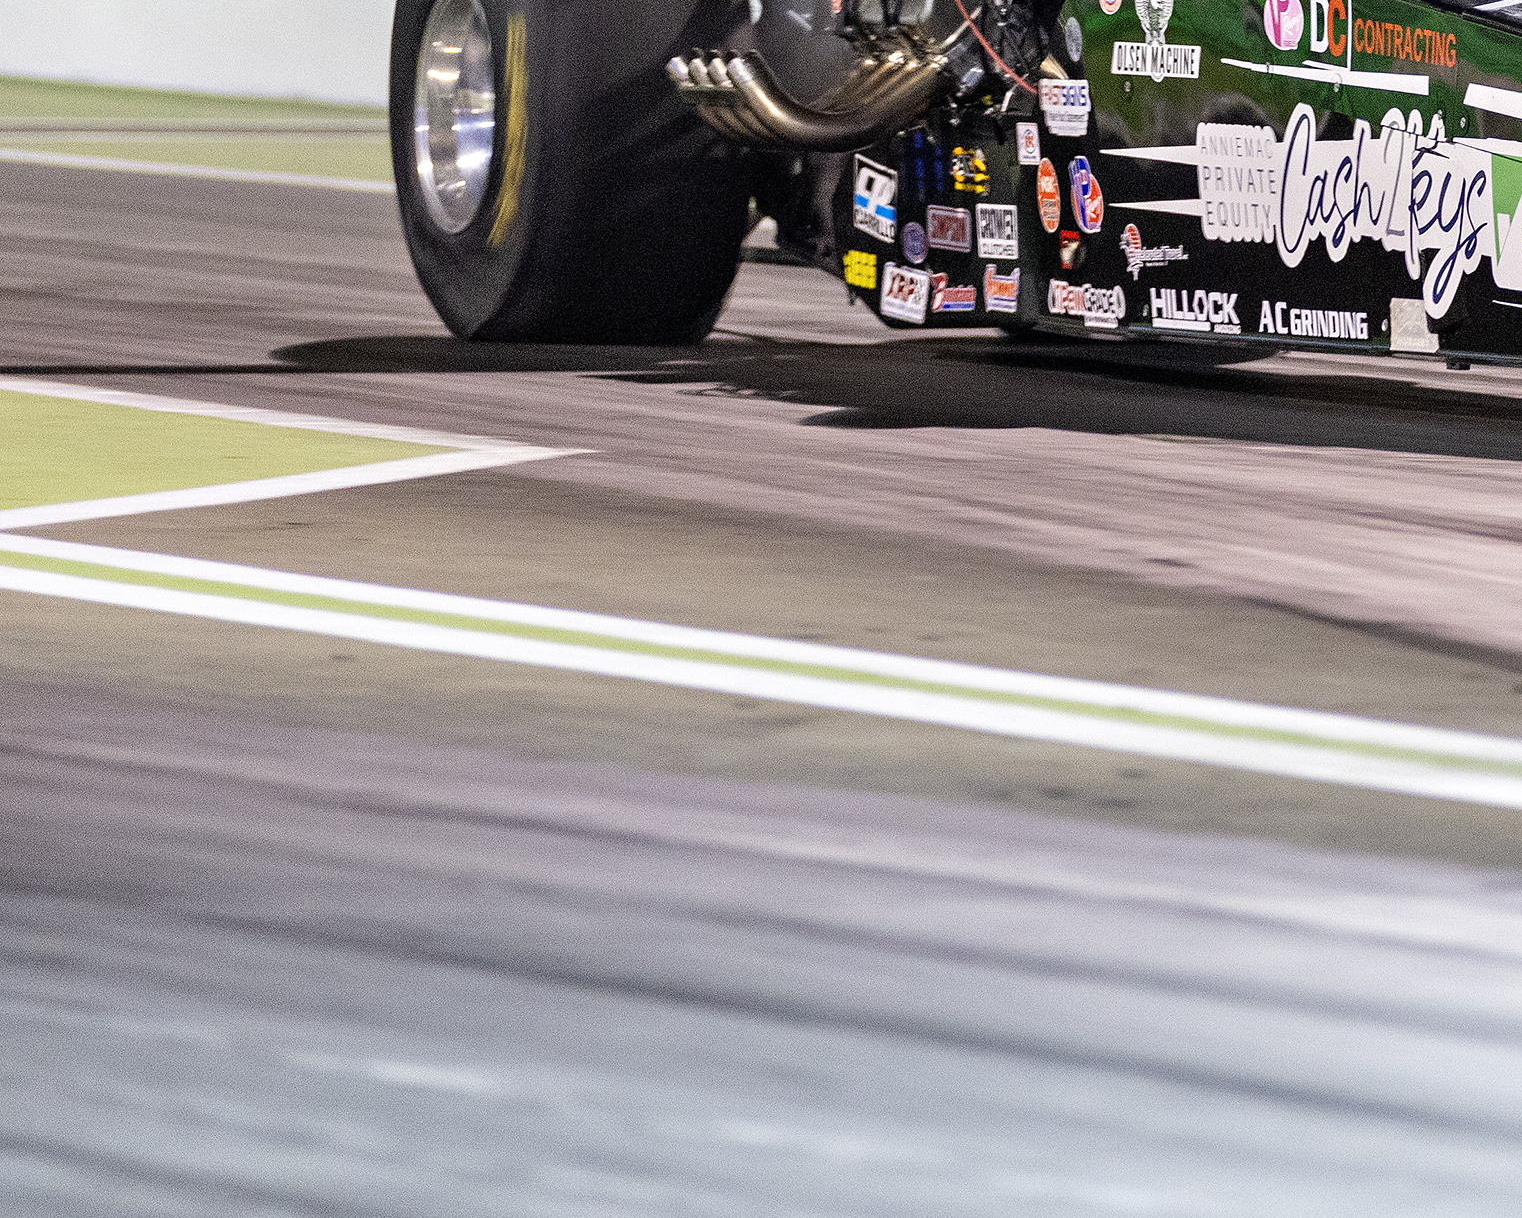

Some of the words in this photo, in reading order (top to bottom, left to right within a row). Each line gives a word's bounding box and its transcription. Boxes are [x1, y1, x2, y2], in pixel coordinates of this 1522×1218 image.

[1354, 18, 1457, 68] CONTRACTING
[1117, 45, 1148, 72] OLSEN
[1151, 46, 1195, 75] MACHINE
[1201, 136, 1274, 159] ANNIEMAC
[1203, 166, 1277, 194] PRIVATE
[1206, 201, 1272, 228] EQUITY
[1151, 288, 1240, 324] HILLOCK
[1259, 300, 1288, 334] AC
[1290, 309, 1369, 339] GRINDING
